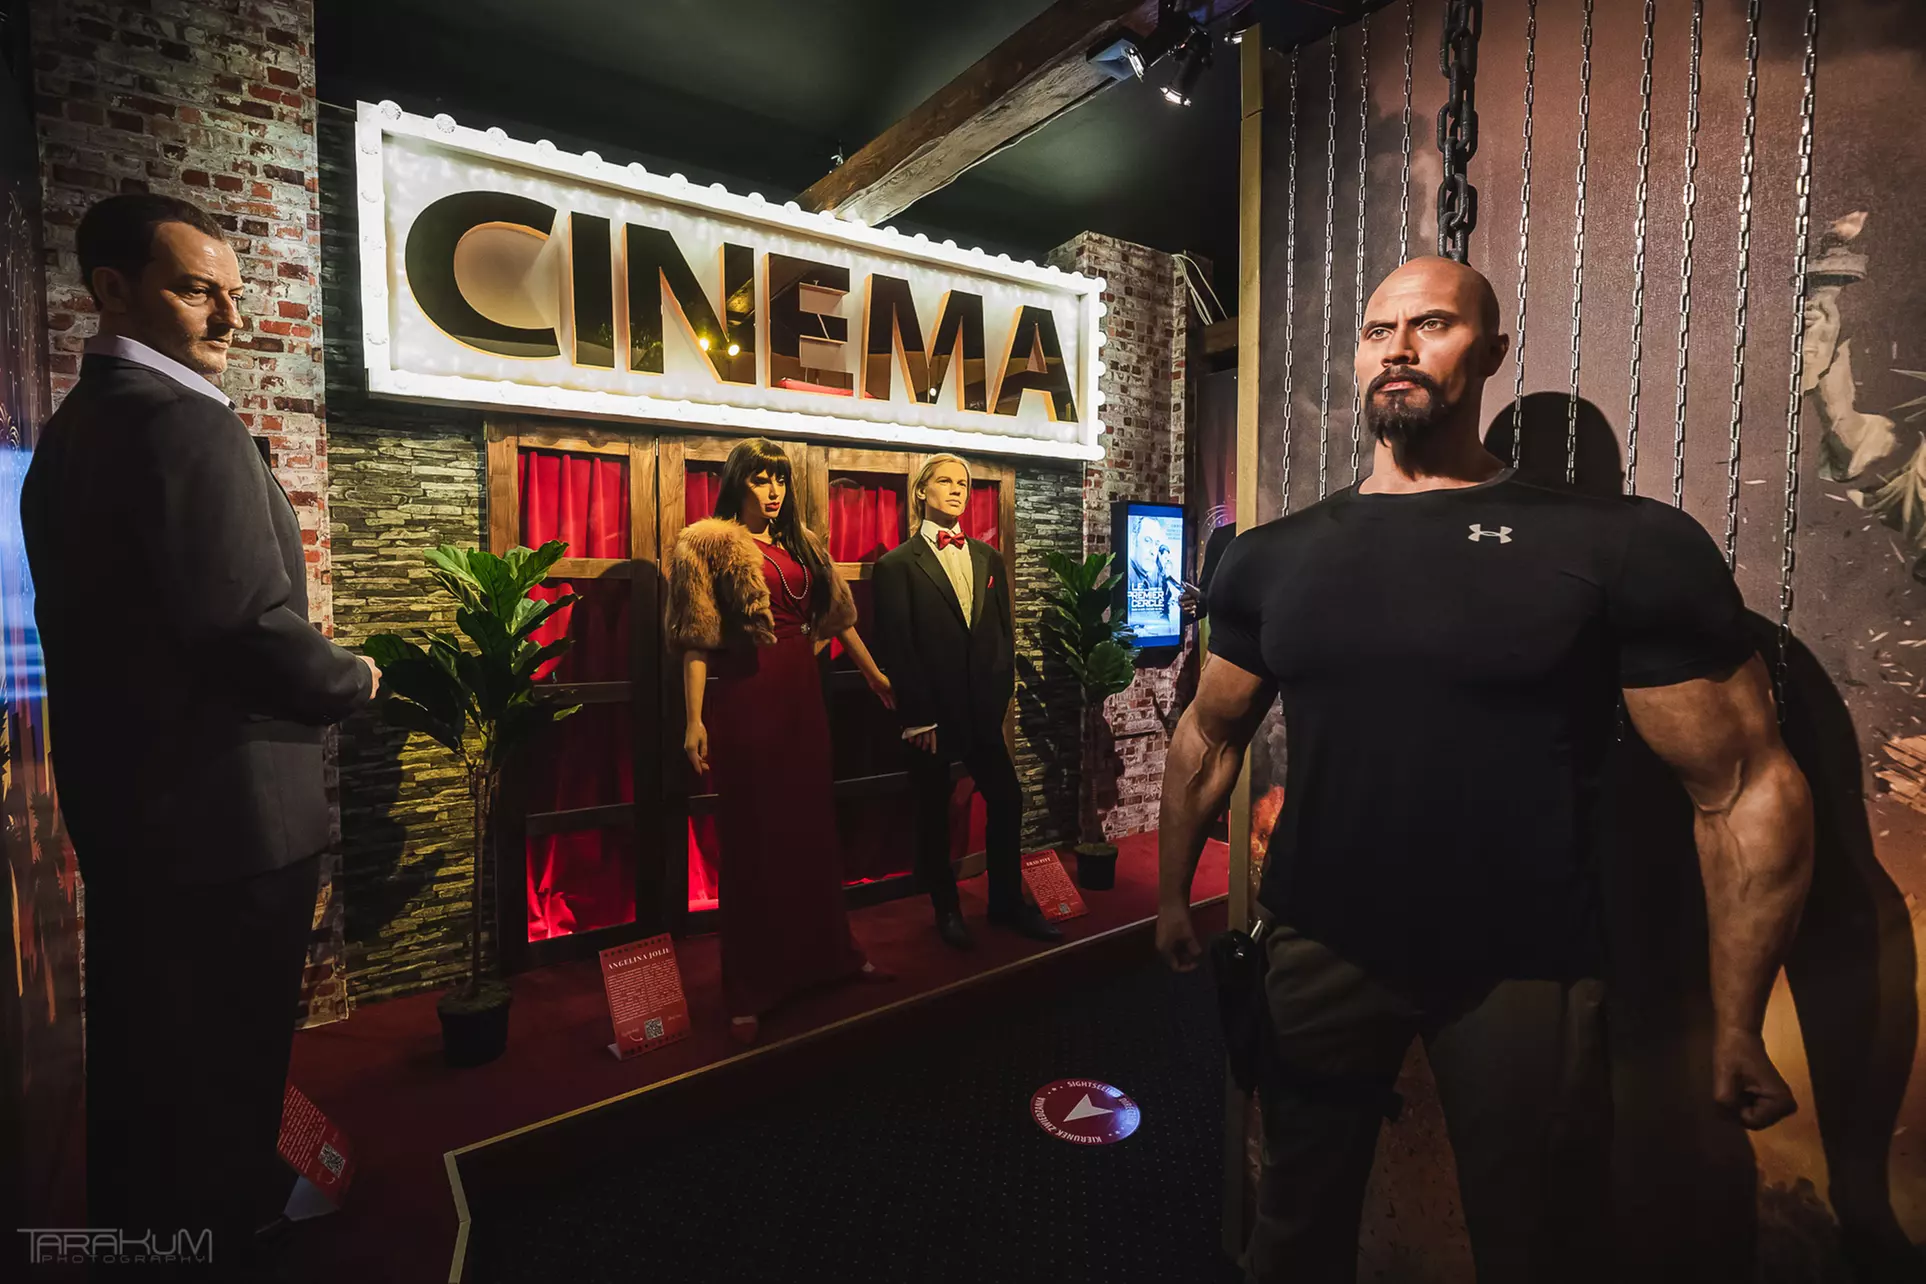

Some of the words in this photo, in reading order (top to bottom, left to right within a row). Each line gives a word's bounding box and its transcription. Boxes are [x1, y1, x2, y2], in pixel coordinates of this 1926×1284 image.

[404, 190, 1079, 423] CINEMA
[1128, 591, 1164, 600] PREMIER
[1131, 582, 1143, 591] LE
[608, 954, 648, 970] ANGELINA
[648, 947, 670, 960] JOLIE
[1034, 1096, 1057, 1132] ZWIEDZANIA
[1055, 1129, 1102, 1143] KIERUNEK
